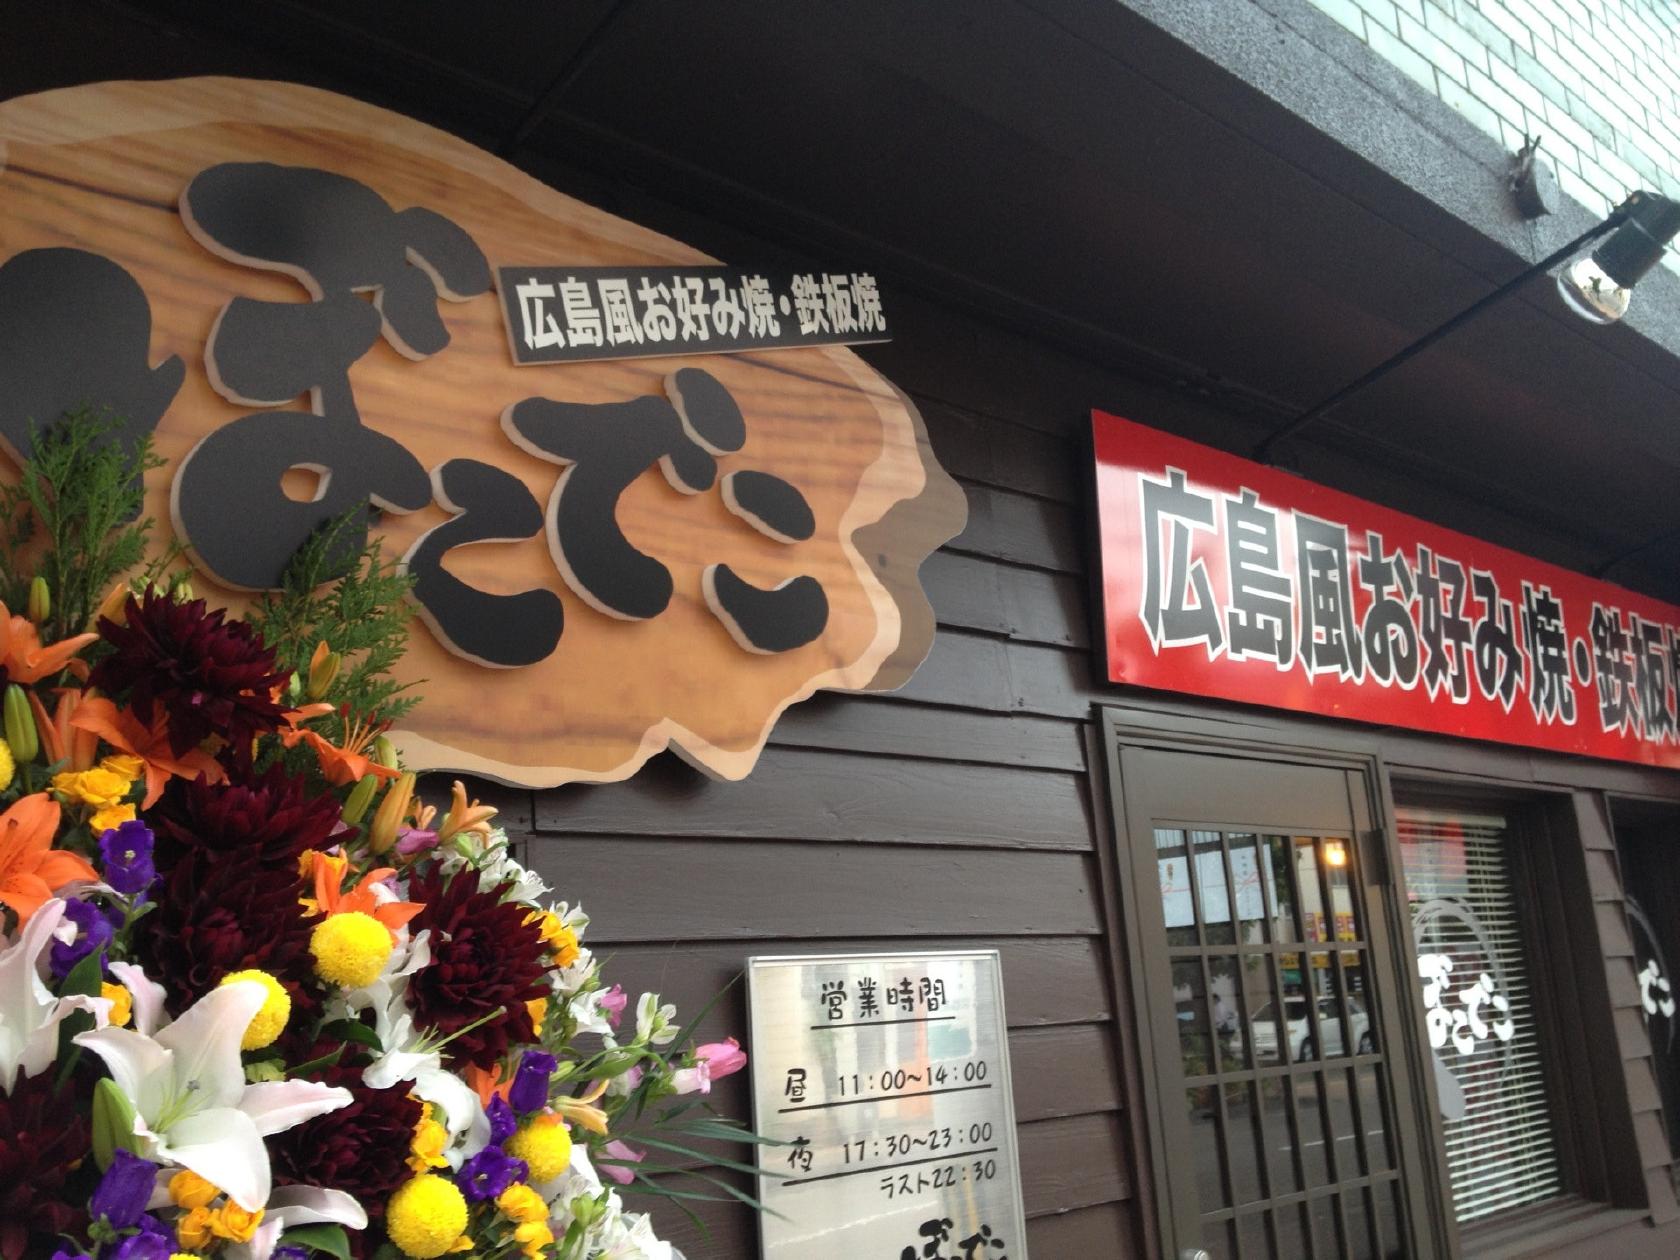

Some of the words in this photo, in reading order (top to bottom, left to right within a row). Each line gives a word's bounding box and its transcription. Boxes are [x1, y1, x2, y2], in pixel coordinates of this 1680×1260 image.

[515, 272, 887, 350] 広島風お好み焼・鉄板焼
[821, 976, 947, 1020] 営業時間
[785, 1067, 808, 1103] 昼
[787, 1136, 814, 1173] 夜
[880, 1159, 997, 1199] ラスト22:30
